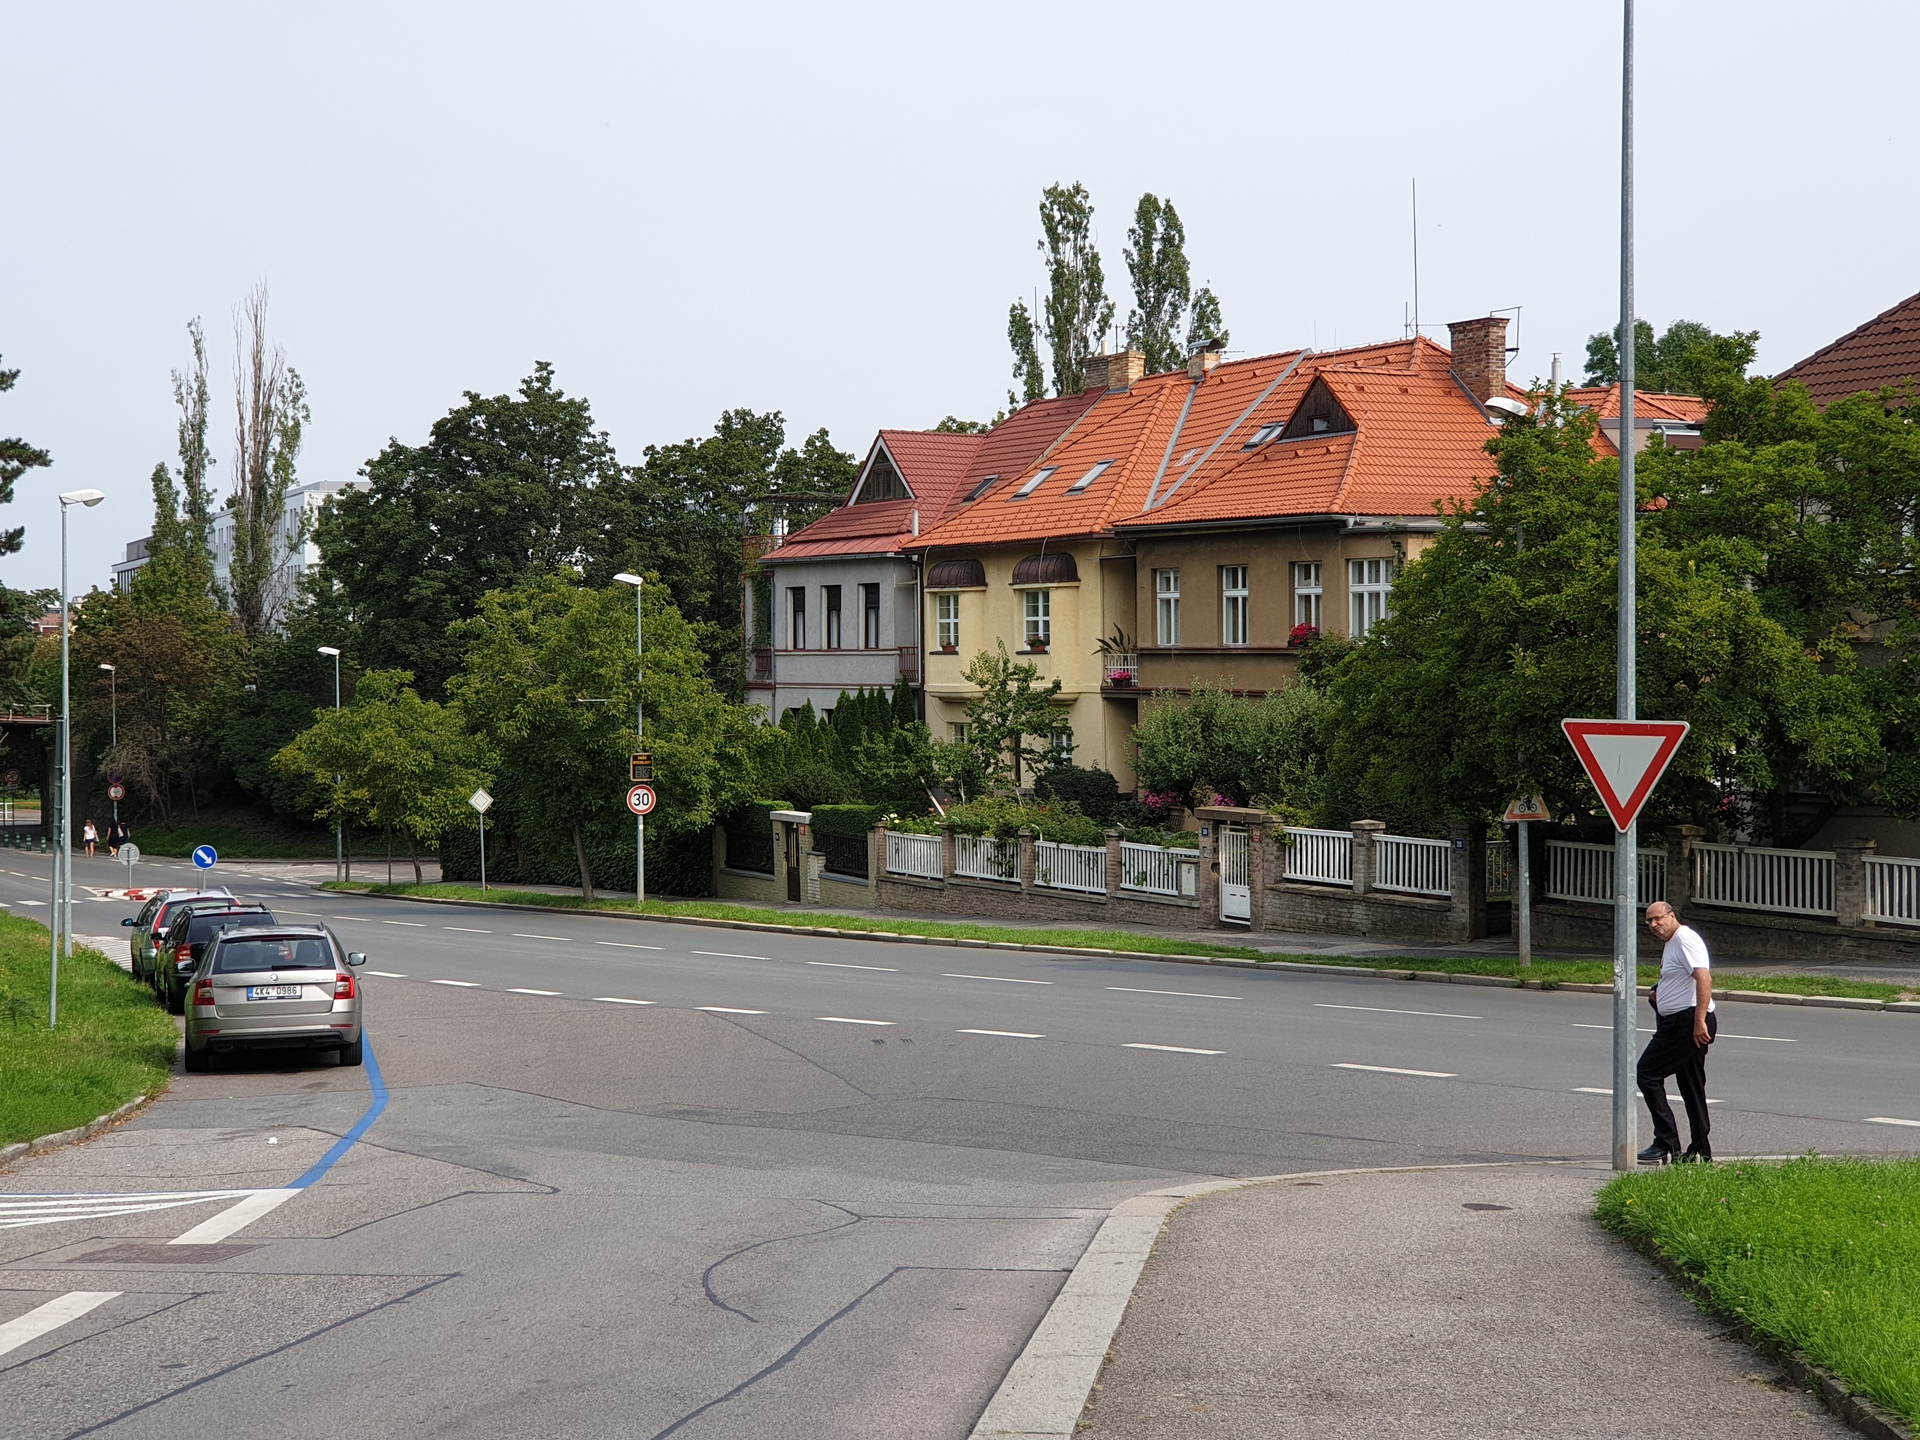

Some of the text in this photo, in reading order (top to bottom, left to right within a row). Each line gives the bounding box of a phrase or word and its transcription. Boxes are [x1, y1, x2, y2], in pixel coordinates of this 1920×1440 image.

[633, 792, 650, 806] 30
[254, 987, 270, 996] 4K4
[276, 986, 298, 995] 0986
